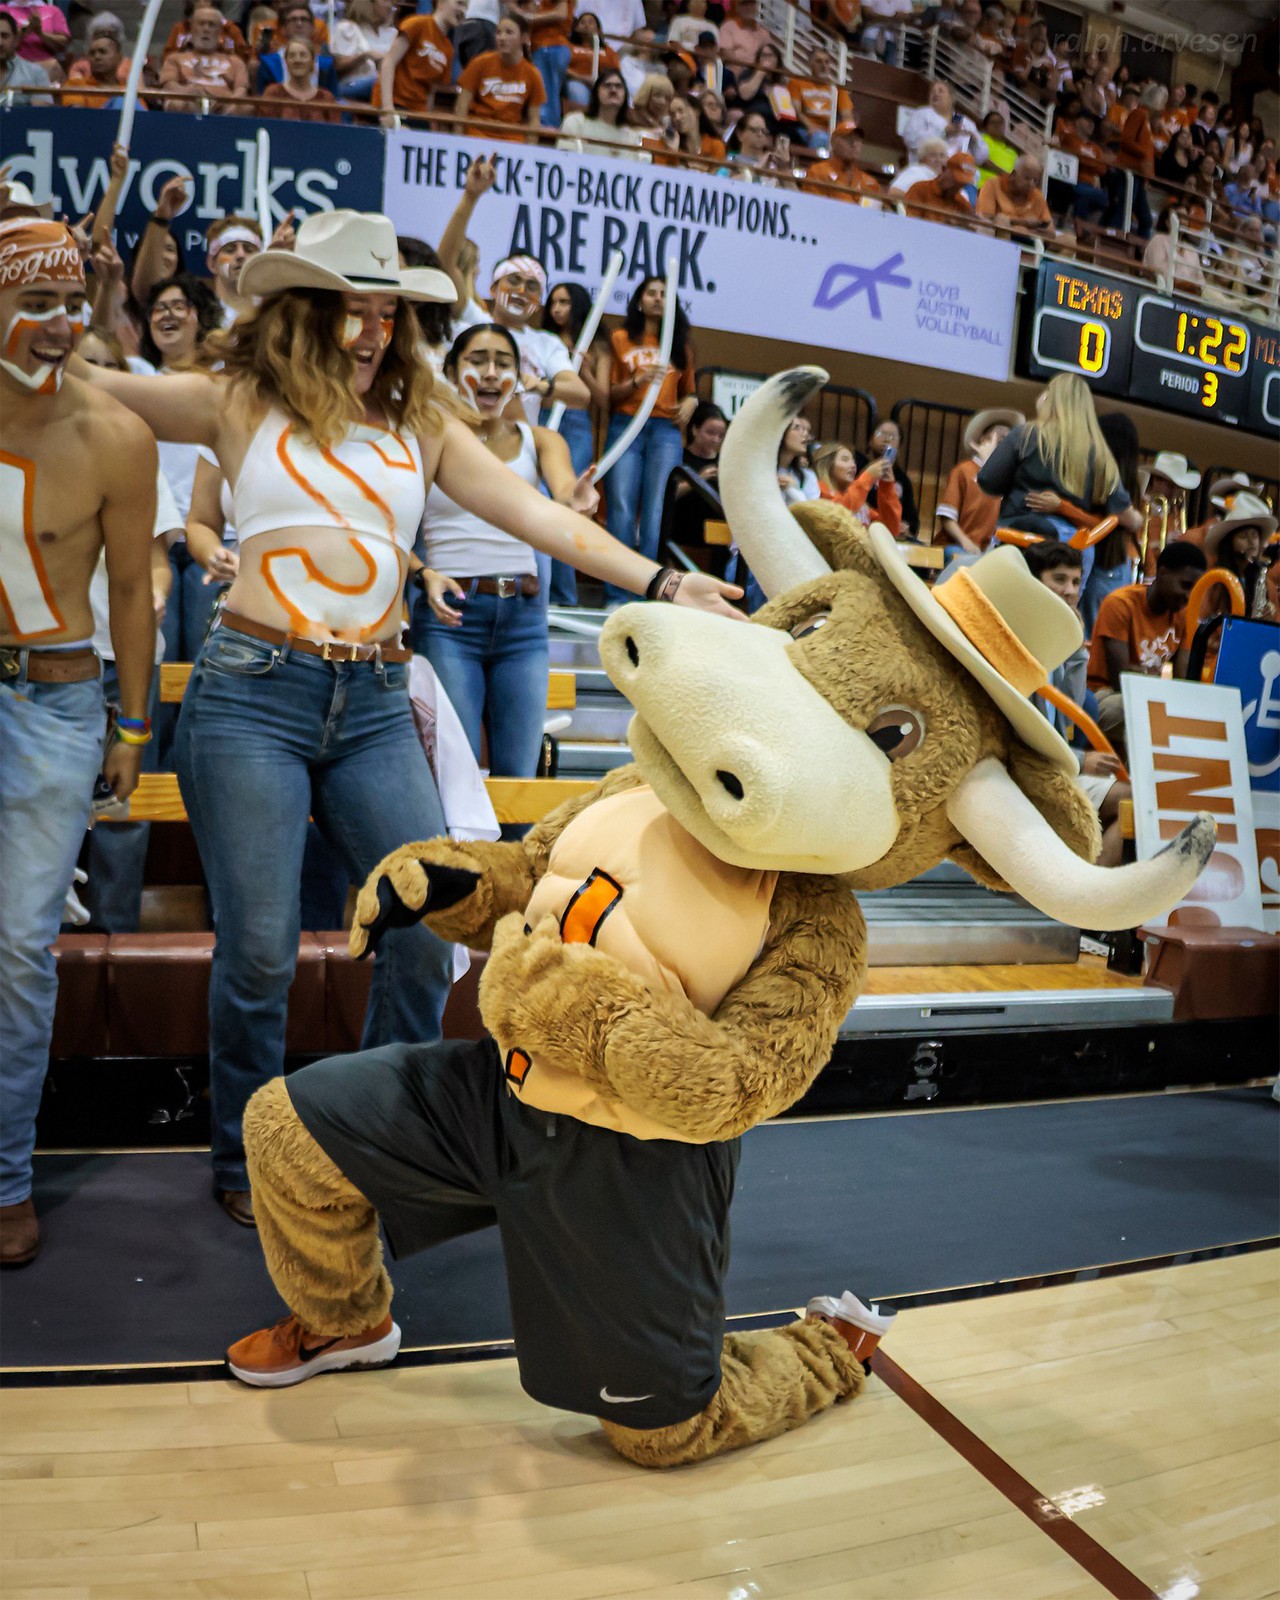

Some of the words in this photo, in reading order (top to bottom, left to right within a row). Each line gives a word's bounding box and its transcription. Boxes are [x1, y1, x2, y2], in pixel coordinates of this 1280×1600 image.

[401, 144, 448, 188] THE
[456, 150, 643, 214] BCK-TO-BACK
[650, 179, 819, 247] CHAMPIONS...
[509, 202, 590, 275] ARE
[600, 214, 717, 294] BACK.
[917, 297, 970, 321] AUSTIN
[1054, 273, 1124, 320] TEXAS
[916, 313, 1003, 347] VOLLEYBALL
[1078, 321, 1106, 373] 0
[1176, 312, 1247, 373] 1:22
[1160, 368, 1200, 395] PERIOD
[1201, 371, 1219, 407] 3
